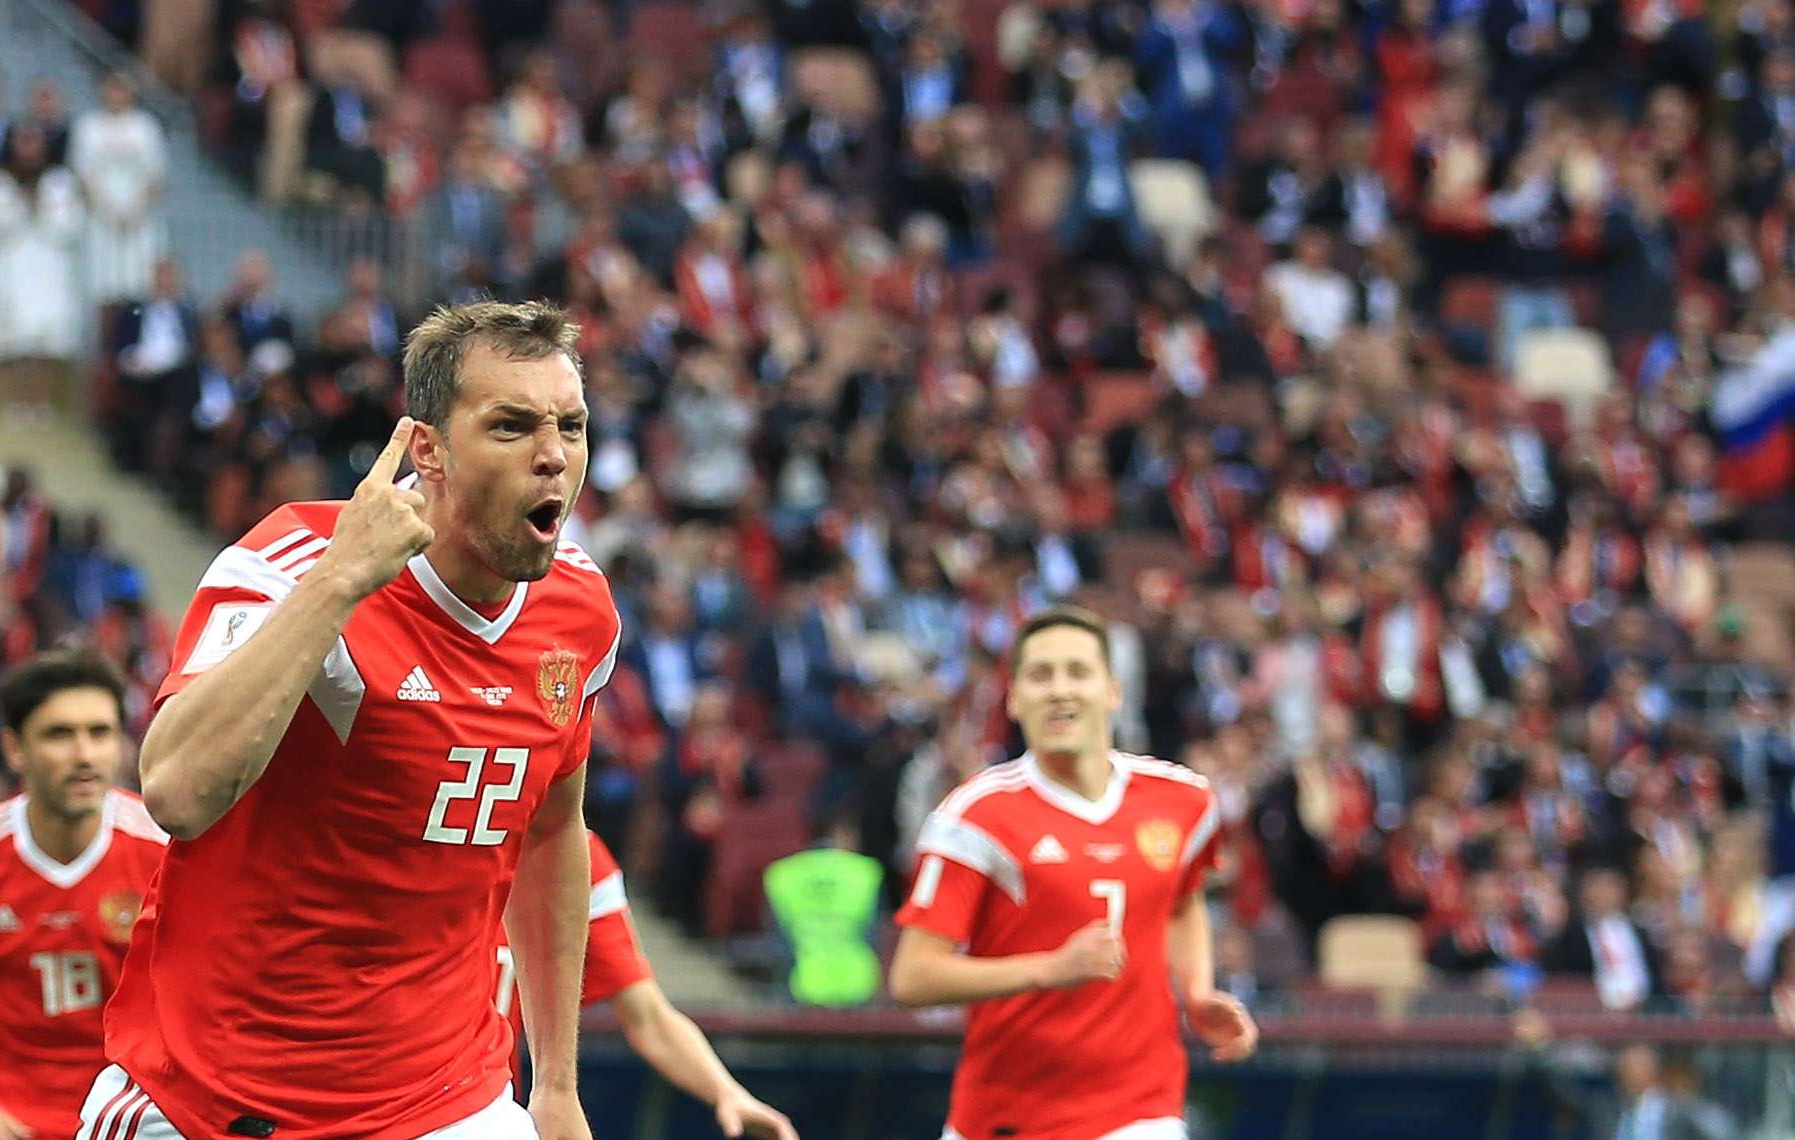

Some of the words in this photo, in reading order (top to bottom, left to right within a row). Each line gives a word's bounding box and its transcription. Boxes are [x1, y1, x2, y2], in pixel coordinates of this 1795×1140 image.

[396, 688, 441, 702] adidas
[422, 746, 531, 846] 22
[1089, 879, 1127, 939] 7
[29, 951, 101, 1017] 18
